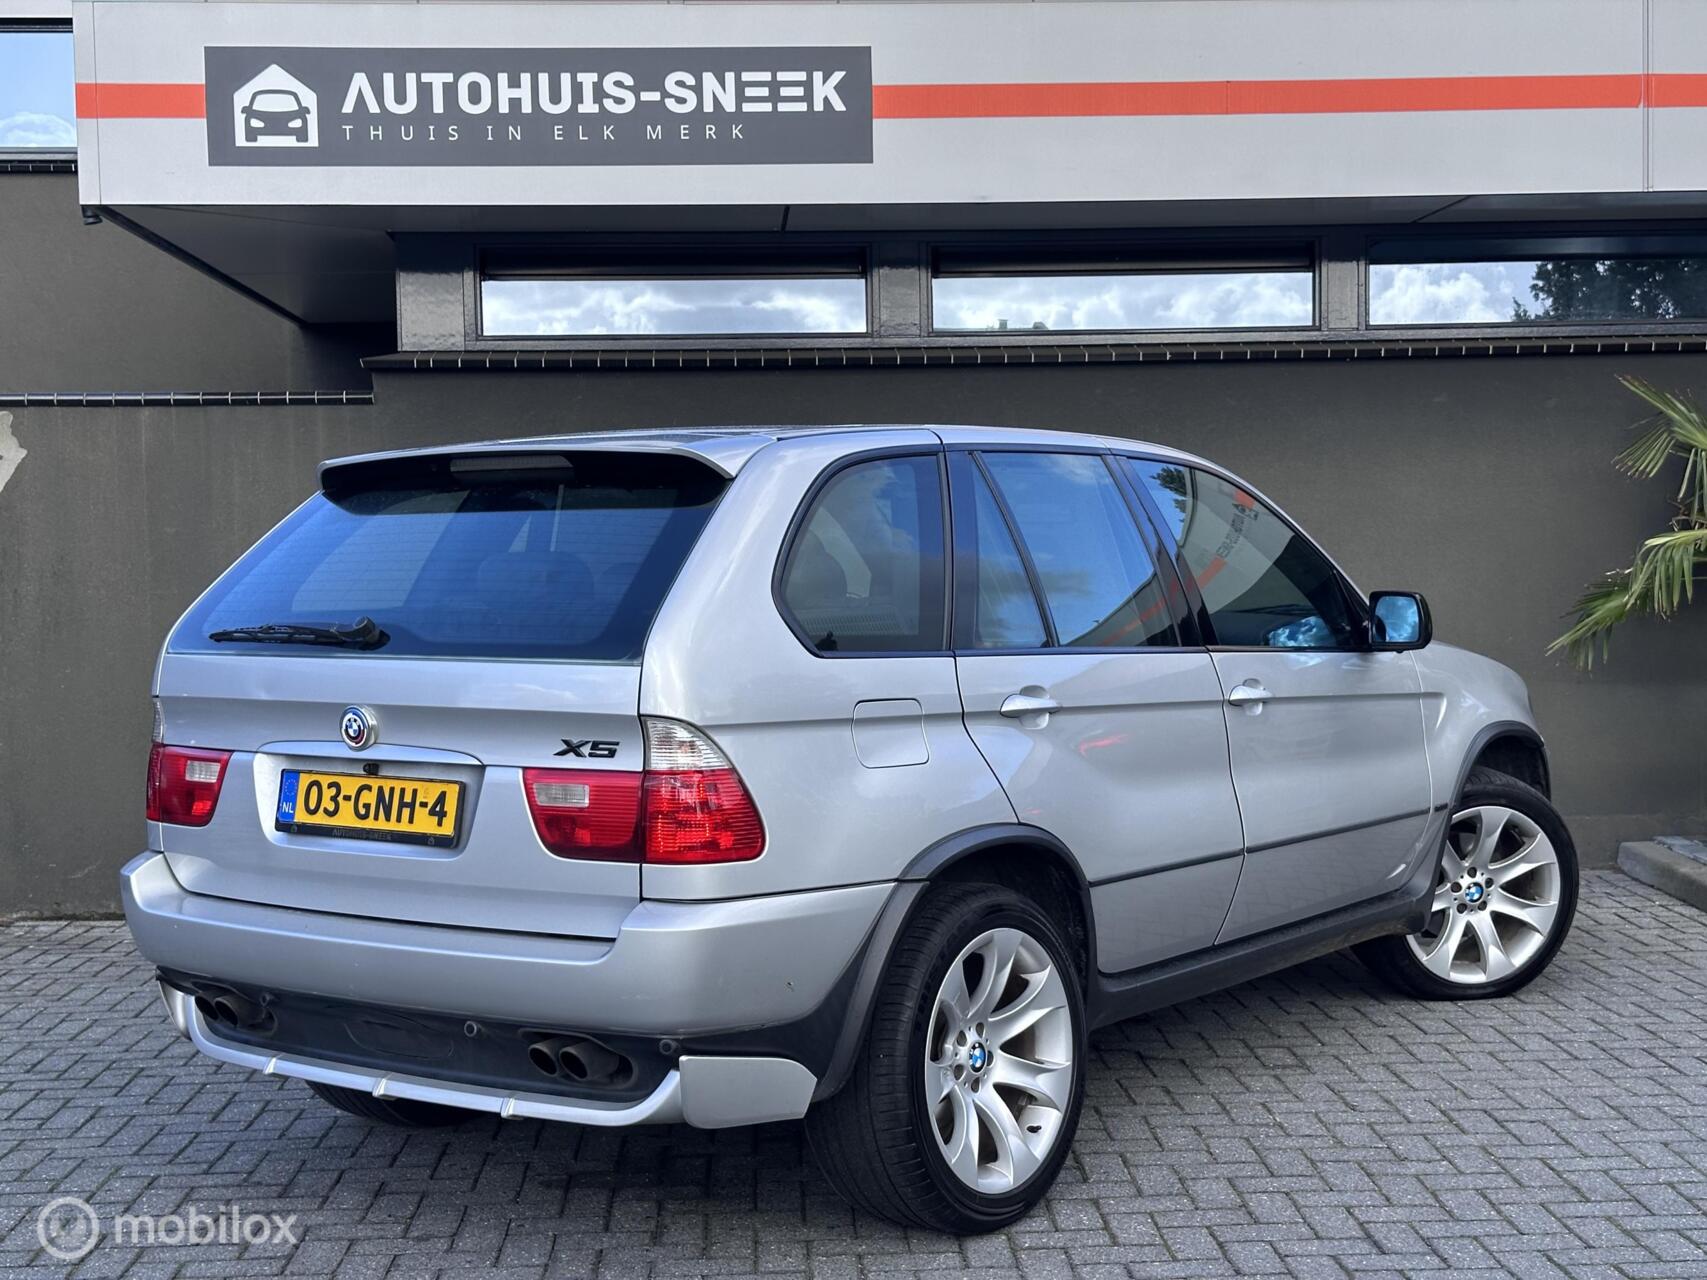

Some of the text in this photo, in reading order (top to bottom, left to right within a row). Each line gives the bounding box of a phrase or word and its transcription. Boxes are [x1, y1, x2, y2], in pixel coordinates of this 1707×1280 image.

[341, 71, 847, 115] AUTOHUIS-SNEEK
[342, 124, 744, 141] THUIS IN ELK MERK
[553, 738, 620, 759] X5
[281, 801, 294, 814] NL
[303, 779, 449, 827] 03-GNH-4
